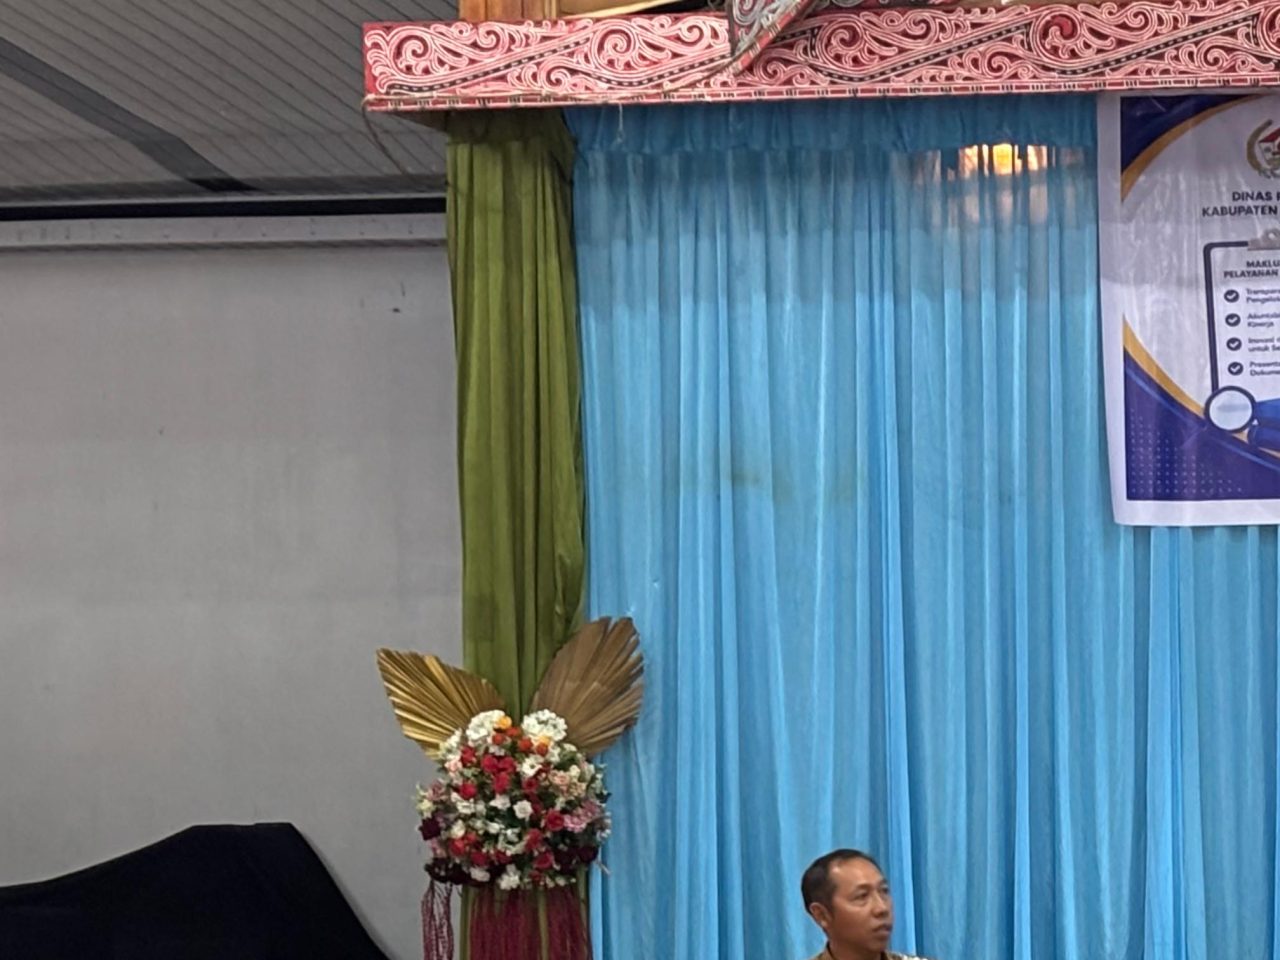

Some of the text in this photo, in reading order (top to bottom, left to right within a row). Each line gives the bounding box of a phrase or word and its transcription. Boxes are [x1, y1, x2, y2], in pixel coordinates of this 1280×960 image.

[1231, 190, 1273, 202] DINAS
[1202, 205, 1278, 218] KABUPATEN
[1223, 269, 1279, 279] PELAYANAN
